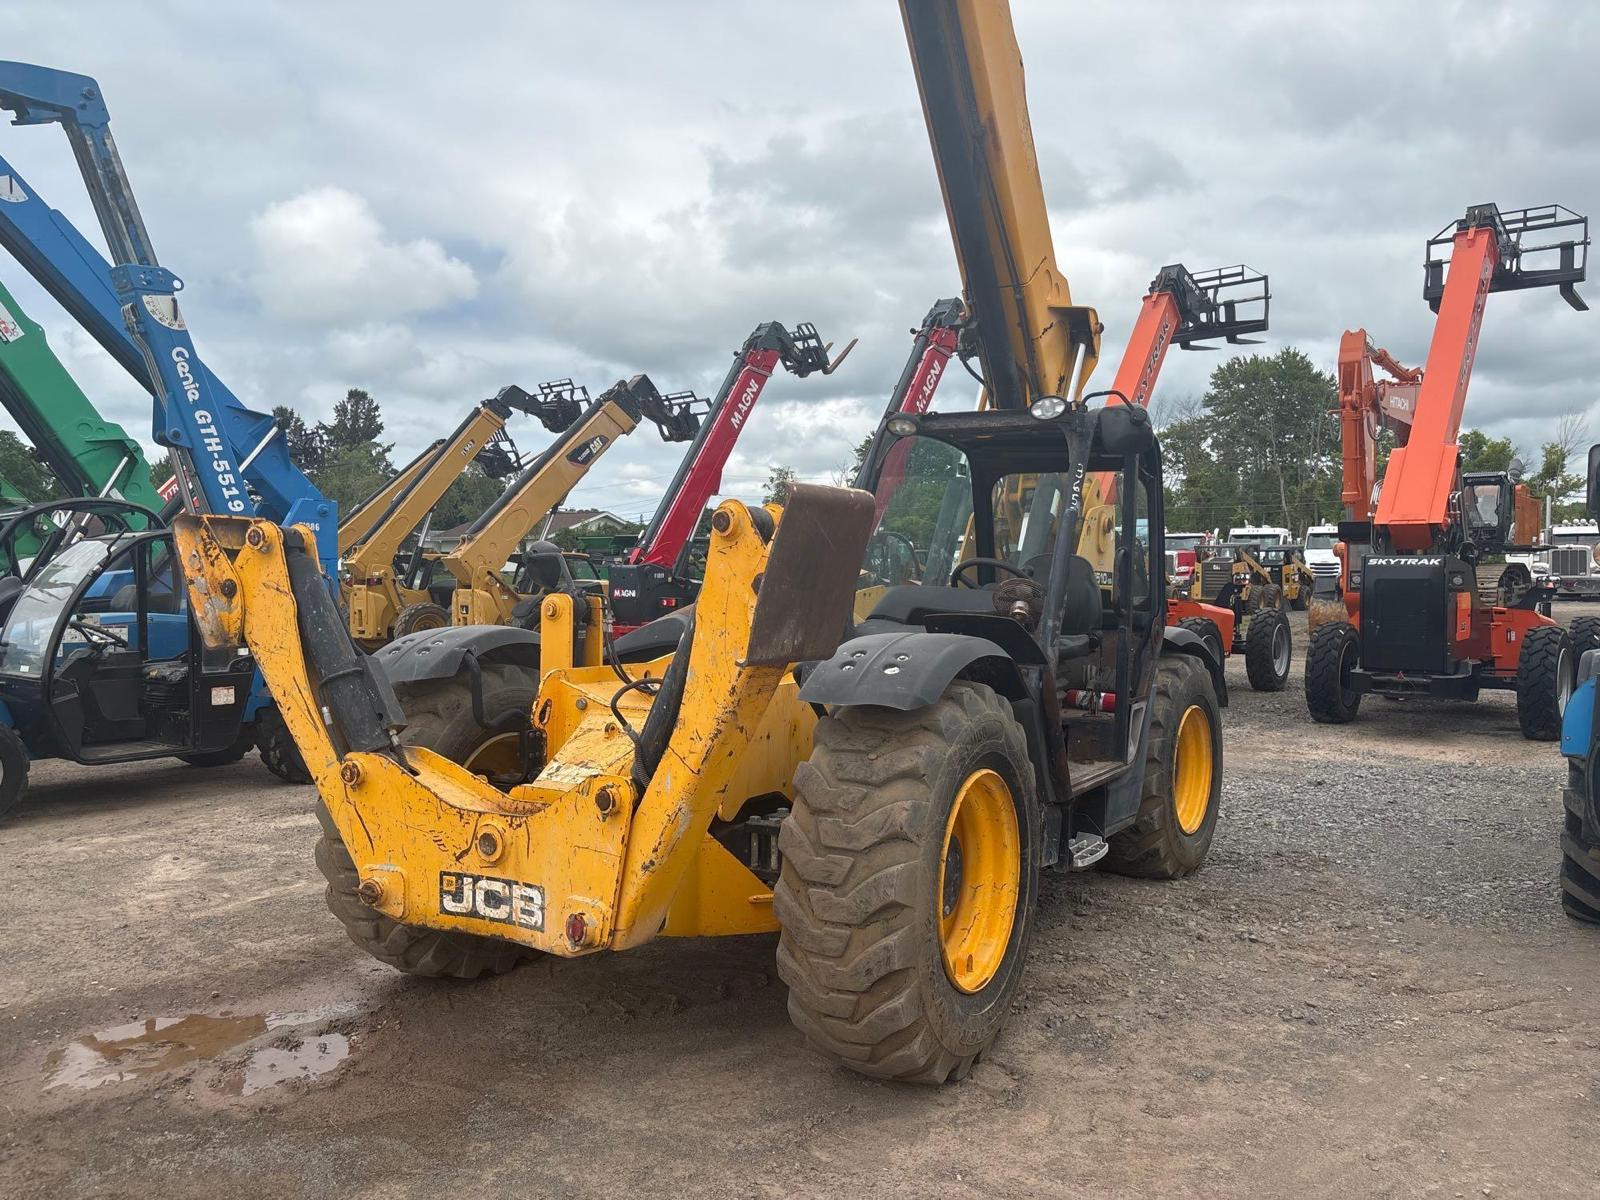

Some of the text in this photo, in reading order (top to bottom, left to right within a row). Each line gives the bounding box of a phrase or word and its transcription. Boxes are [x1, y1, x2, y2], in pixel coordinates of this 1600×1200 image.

[1136, 312, 1171, 404] KYTRAK
[730, 378, 759, 429] MAGNI
[916, 359, 941, 413] MAGNI
[1389, 395, 1410, 411] HITACHI
[172, 346, 245, 512] Genie GTH-5519
[589, 436, 603, 454] CAT
[614, 589, 637, 597] MAGNI
[441, 875, 544, 928] JCB
